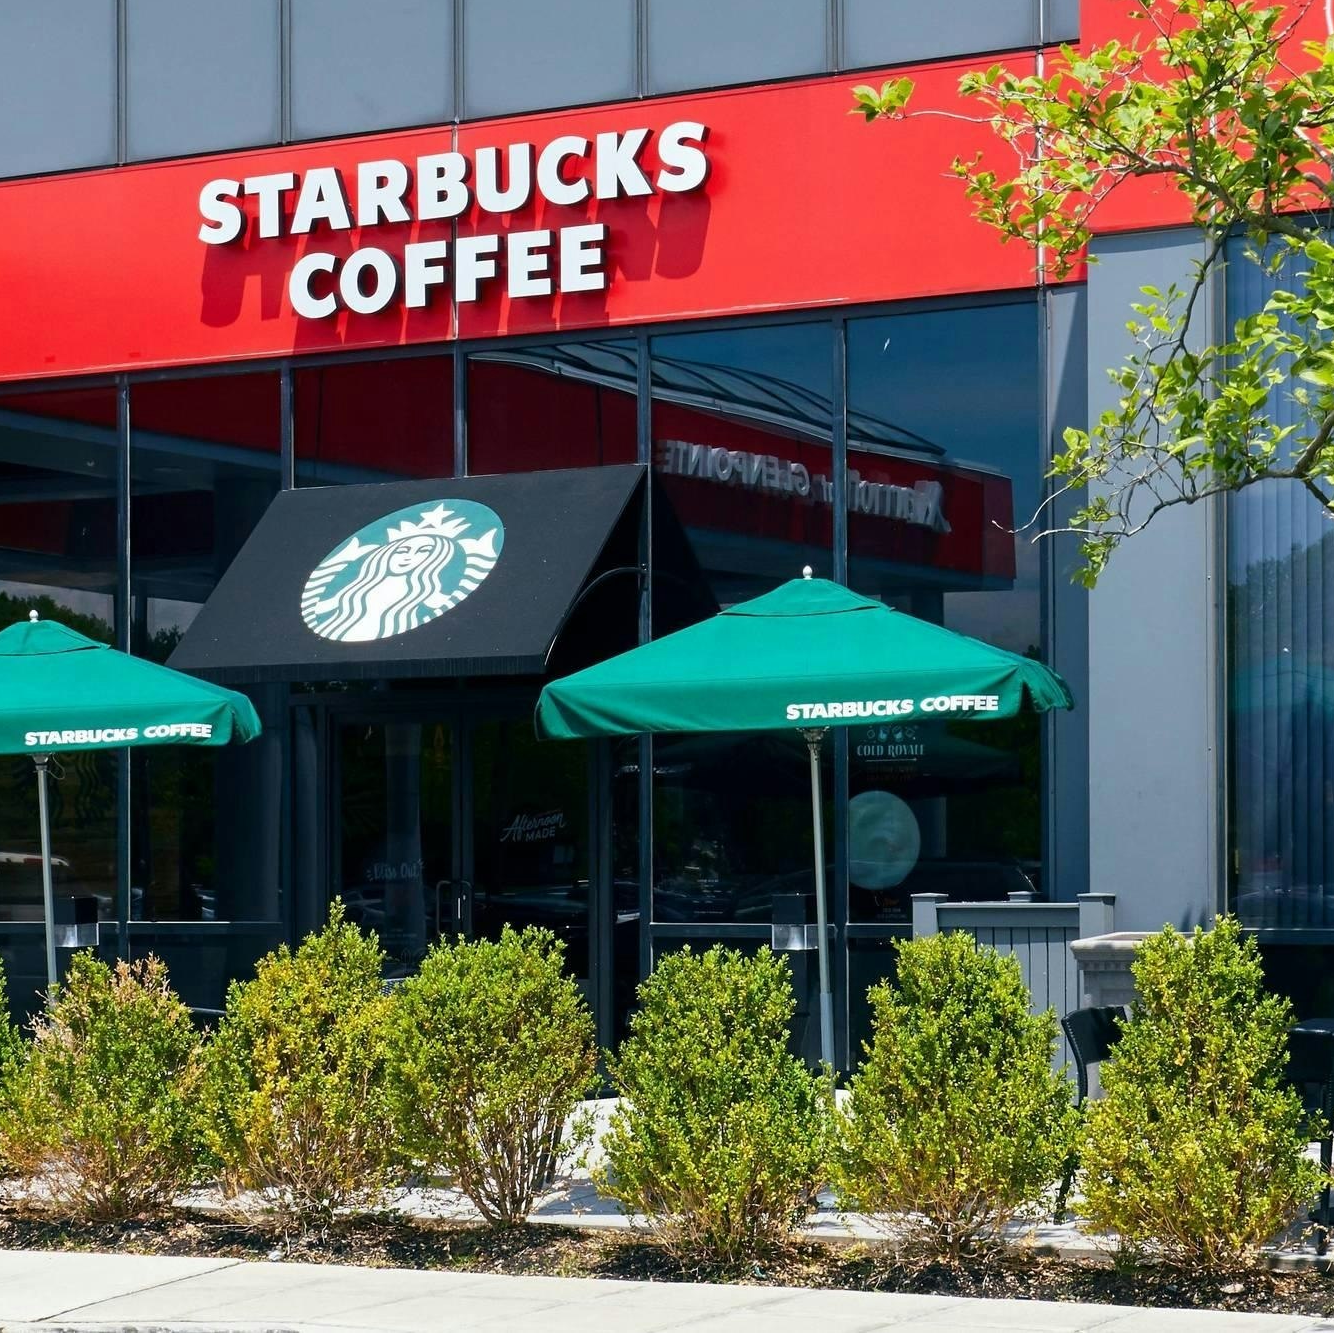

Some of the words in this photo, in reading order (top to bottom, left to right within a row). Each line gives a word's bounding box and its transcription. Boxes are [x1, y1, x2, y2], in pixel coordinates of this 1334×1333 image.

[198, 121, 710, 246] STARBUCKS
[288, 223, 609, 319] COFFEE
[786, 699, 914, 720] STARBUCKS
[920, 695, 999, 711] COFFEE
[24, 728, 138, 746] STARBUCKS
[143, 723, 212, 738] COFFEE
[856, 744, 884, 757] COLD
[526, 826, 556, 841] MADE
